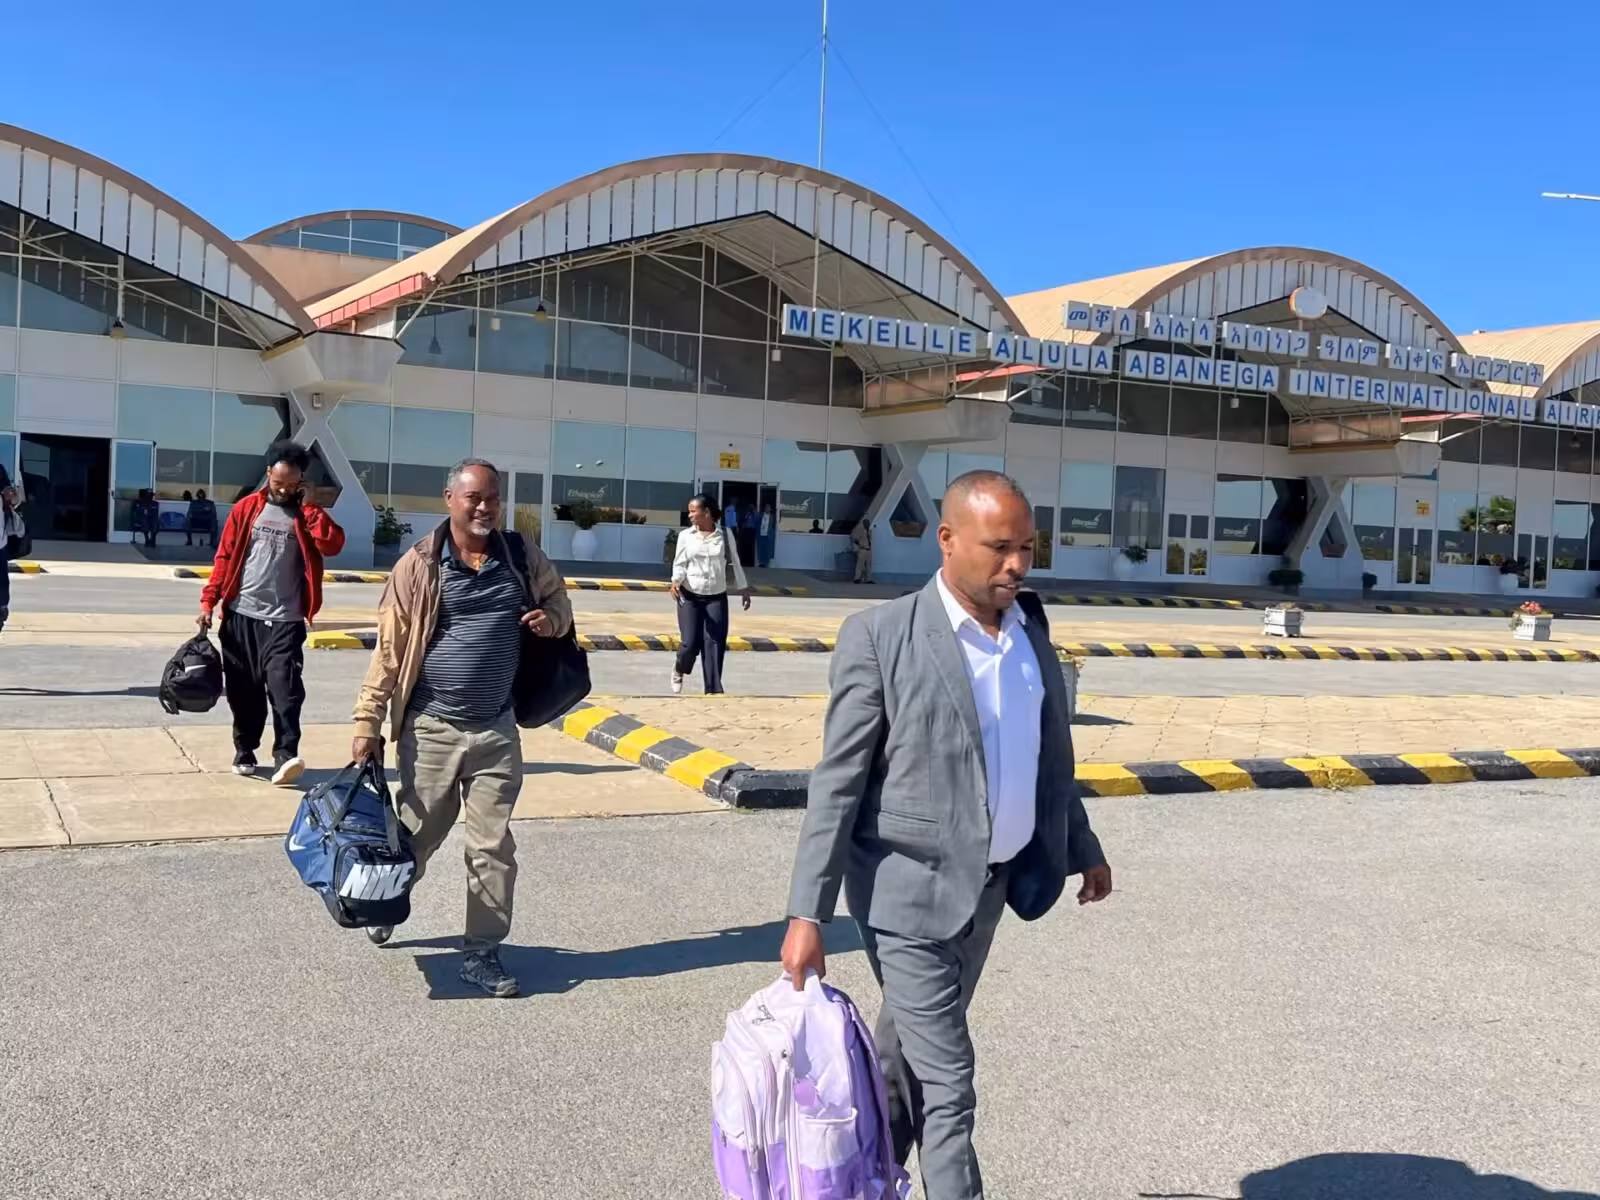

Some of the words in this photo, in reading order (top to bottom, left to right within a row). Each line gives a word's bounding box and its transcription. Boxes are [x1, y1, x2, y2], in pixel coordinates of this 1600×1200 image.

[789, 308, 973, 353] MEKELLE
[994, 342, 1109, 370] ALULA
[1129, 354, 1276, 387] ABANEGA
[1297, 374, 1535, 417] INTERNATIONAL
[338, 861, 415, 901] NIKE
